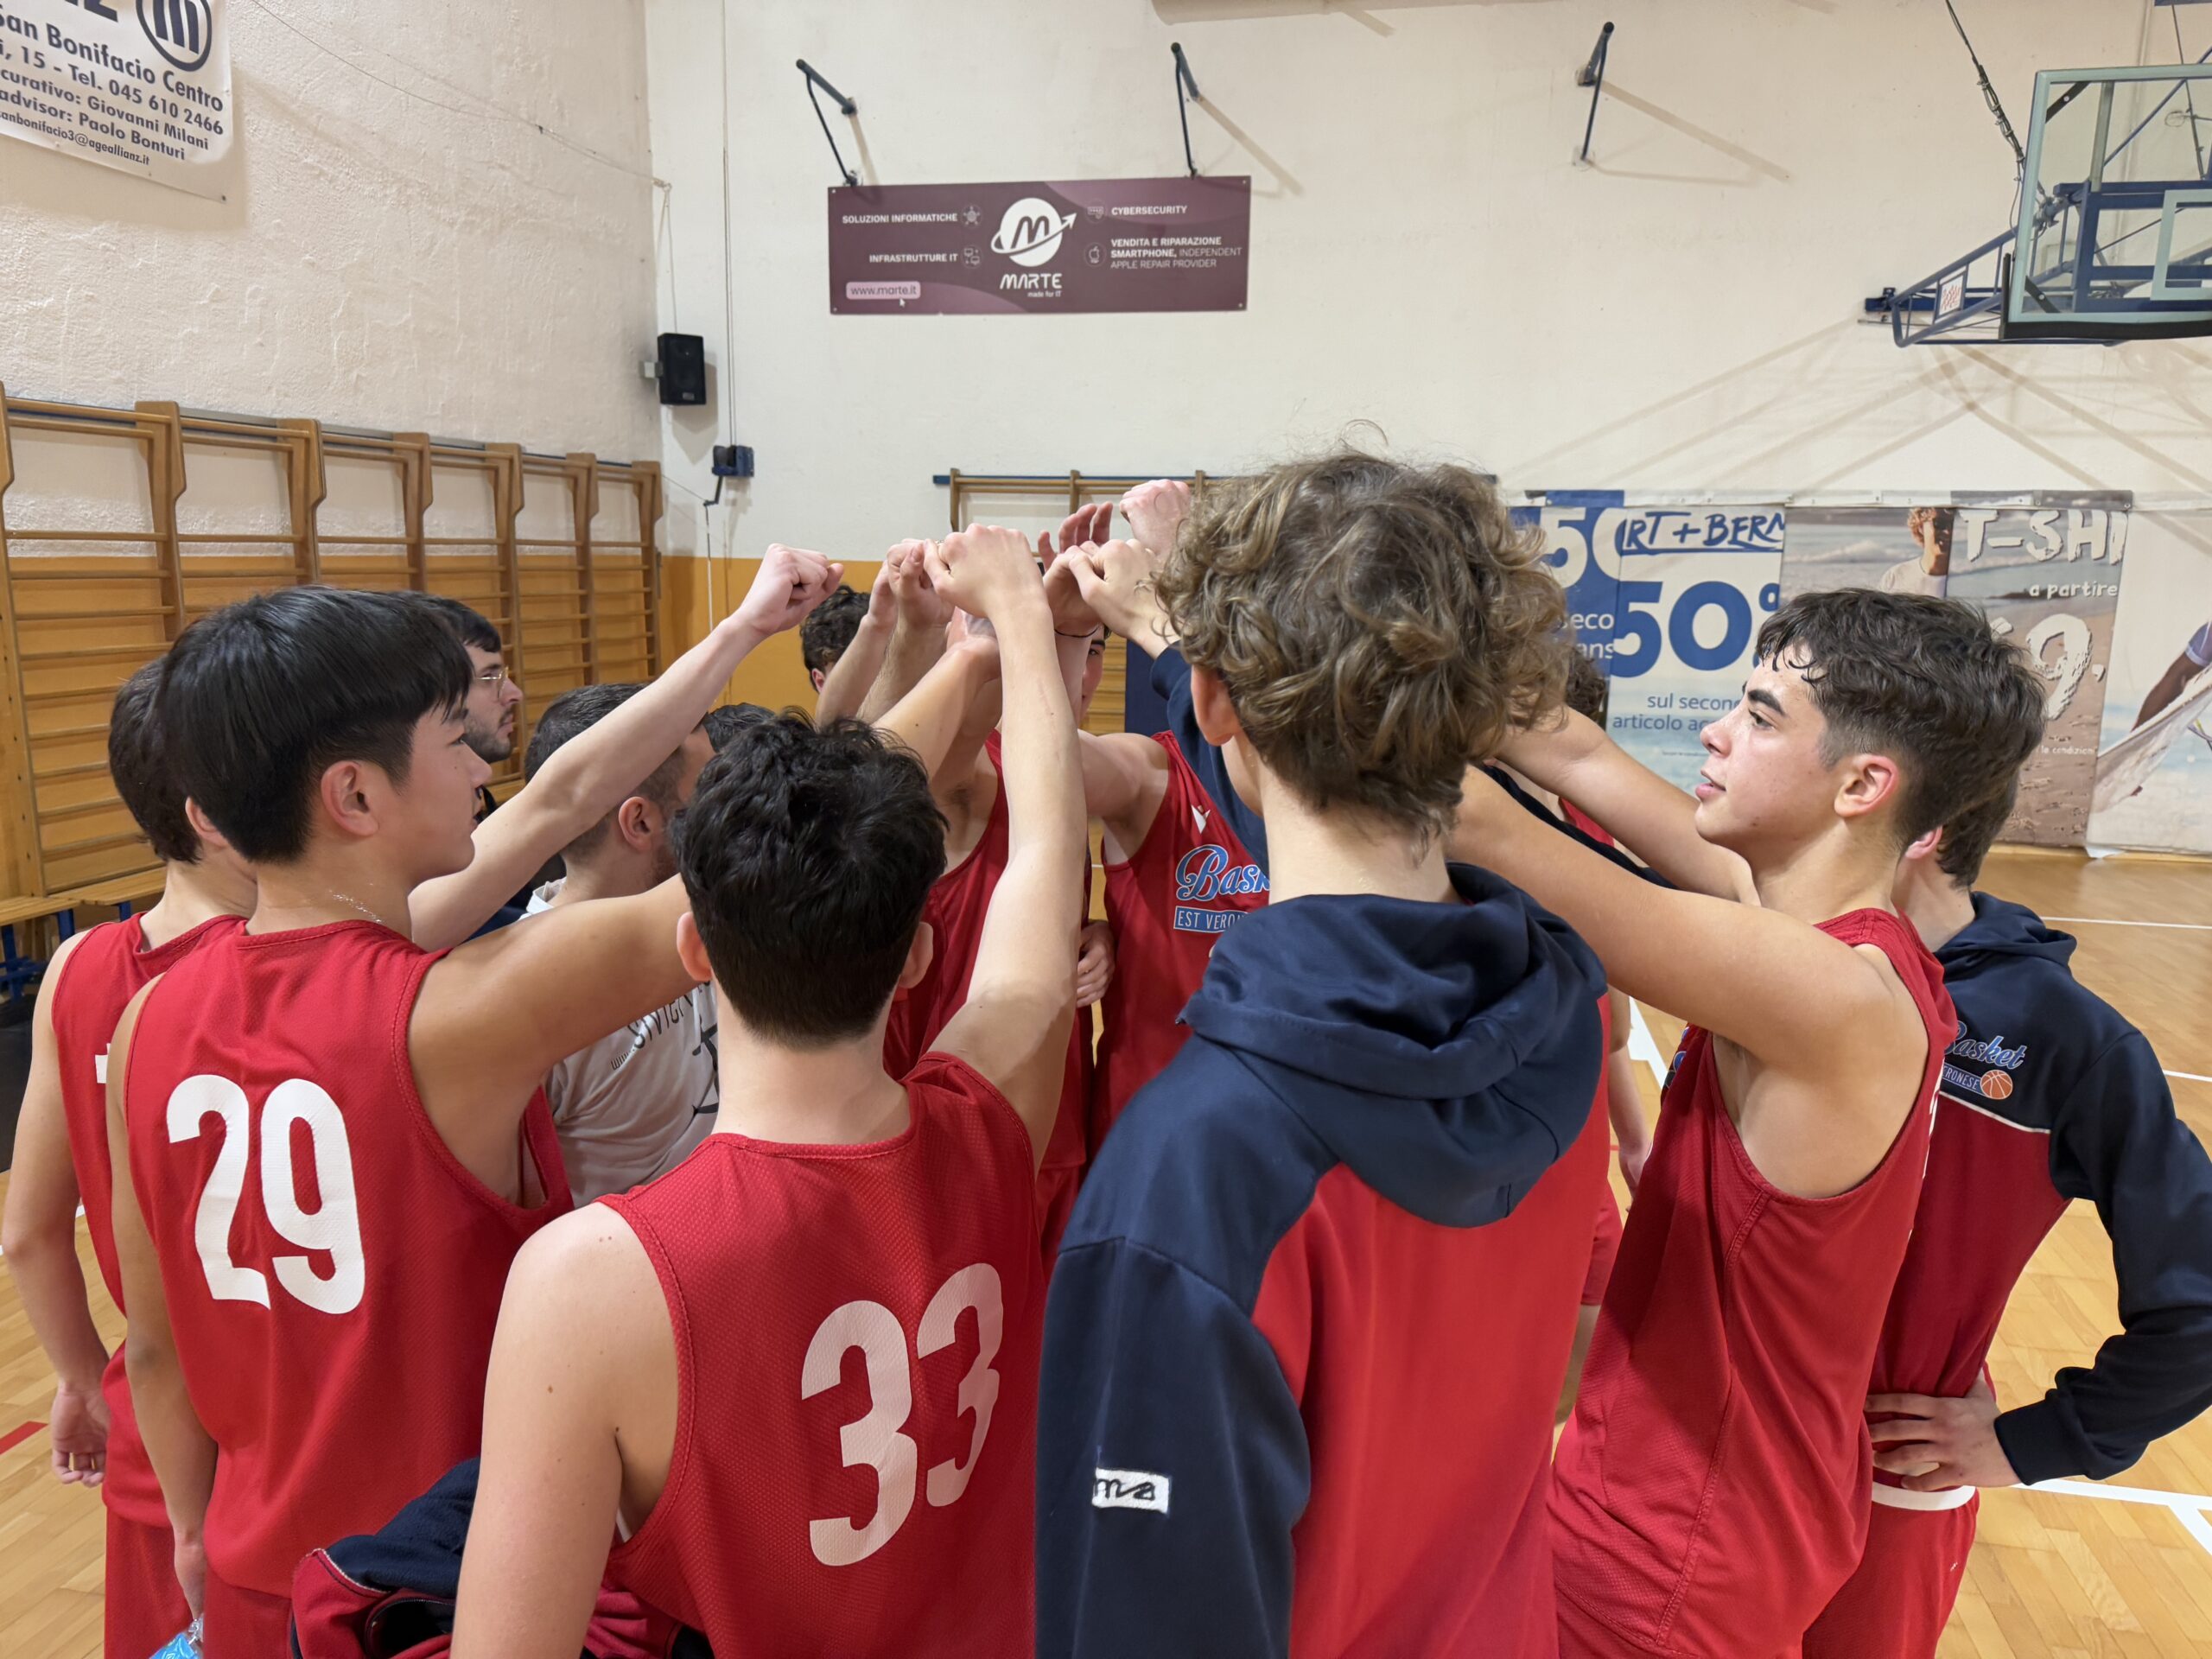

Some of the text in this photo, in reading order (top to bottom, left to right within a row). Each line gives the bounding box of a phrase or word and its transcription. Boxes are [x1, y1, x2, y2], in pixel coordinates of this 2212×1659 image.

[47, 23, 156, 84] Bonifacio
[162, 71, 224, 112] Centro
[22, 46, 46, 69] 15
[68, 64, 103, 91] Tel.
[109, 79, 143, 104] 045
[149, 95, 179, 118] 610
[183, 109, 224, 135] 2466
[1, 69, 208, 150] curativo: Giovanni Milani
[0, 90, 185, 160] advisor: Paolo Bonturi
[0, 111, 149, 165] anbonifacio3@ageallianz.it
[842, 213, 958, 224] SOLUZIONI INFORMATICHE
[1111, 206, 1188, 215] CYBERSECURITY
[1111, 237, 1222, 246] VENDITA E RIPARAZIONE
[869, 253, 958, 264] INFRASTRUTTURE IT
[1111, 247, 1242, 258] SMARTPHONE, INDEPENDENT
[1110, 259, 1217, 269] APPLE REPAIR PROVIDER
[1000, 273, 1063, 289] MARTE
[850, 285, 918, 296] www.marte.it
[2030, 581, 2118, 600] a partire
[1648, 693, 1673, 709] sul
[1612, 714, 1682, 731] articolo
[1178, 911, 1244, 931] EST VERO
[166, 1074, 365, 1314] 29
[801, 1262, 1004, 1567] 33
